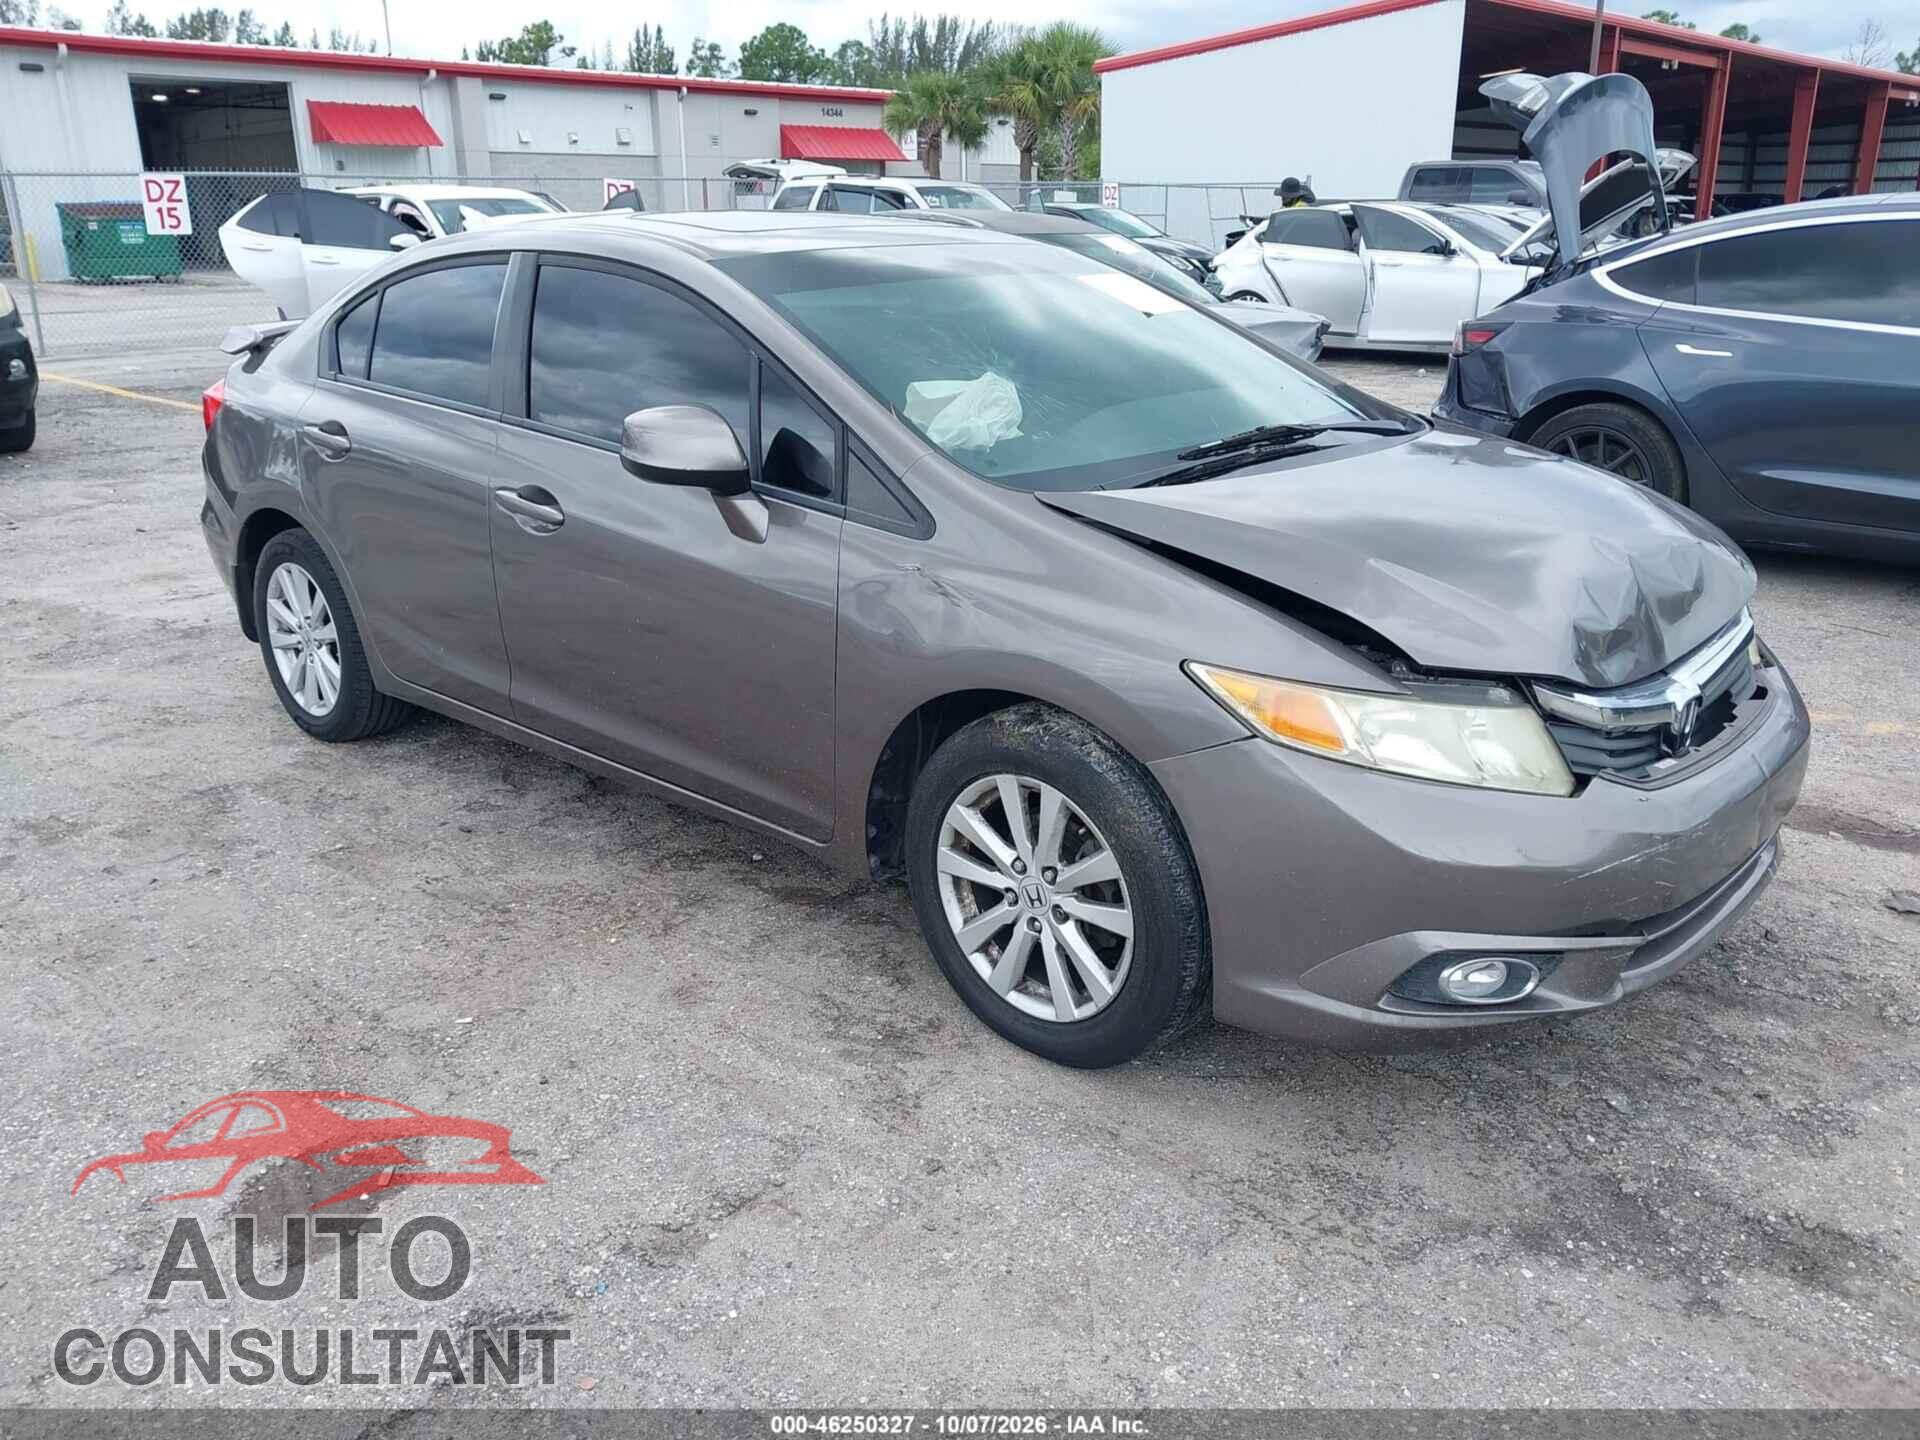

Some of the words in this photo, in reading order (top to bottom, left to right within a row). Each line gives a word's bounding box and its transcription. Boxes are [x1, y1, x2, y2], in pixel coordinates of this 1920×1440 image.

[821, 107, 843, 118] 14344
[144, 179, 183, 203] DZ
[1104, 185, 1117, 200] DZ
[156, 206, 182, 229] 15
